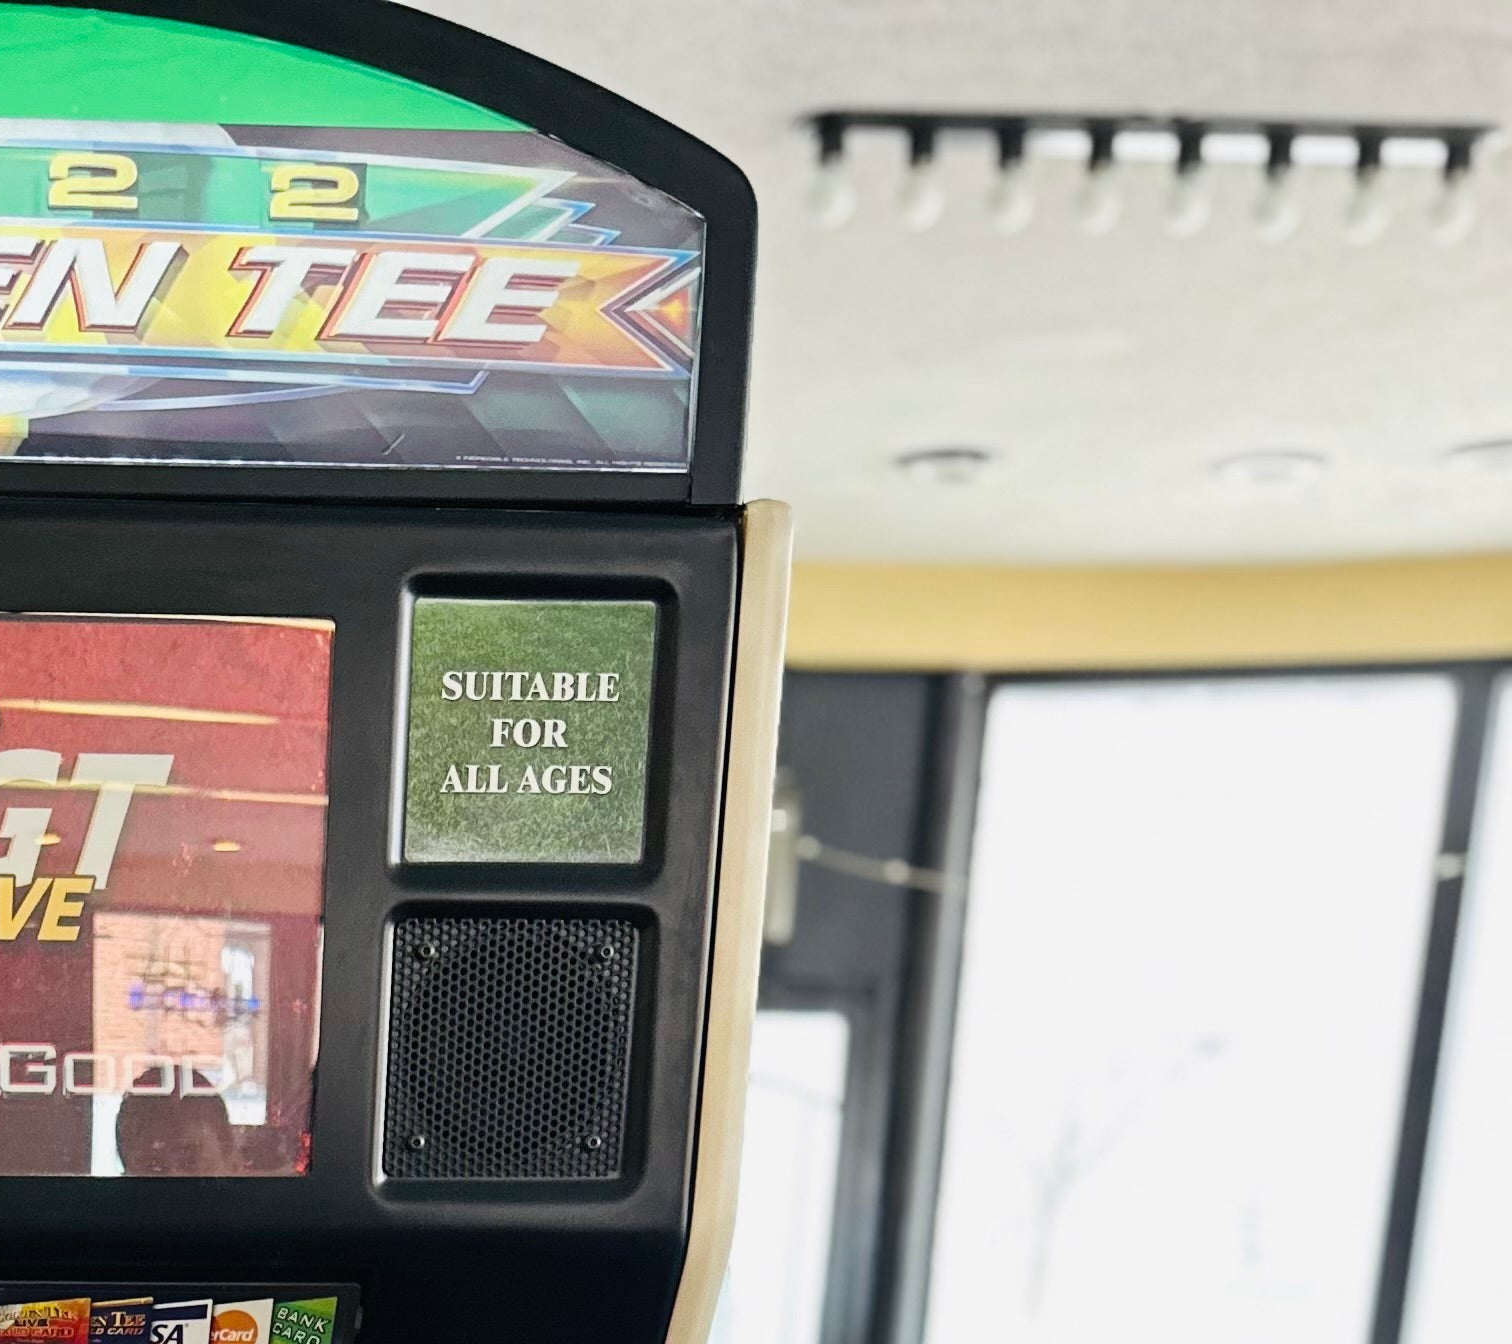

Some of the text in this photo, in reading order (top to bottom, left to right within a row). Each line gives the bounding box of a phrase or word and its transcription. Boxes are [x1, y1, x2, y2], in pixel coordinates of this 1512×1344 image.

[227, 243, 581, 347] TEE
[441, 671, 620, 702] SUITABLE
[489, 718, 569, 748] FOR
[439, 764, 614, 795] ALL AGES
[277, 1307, 329, 1334] BANK
